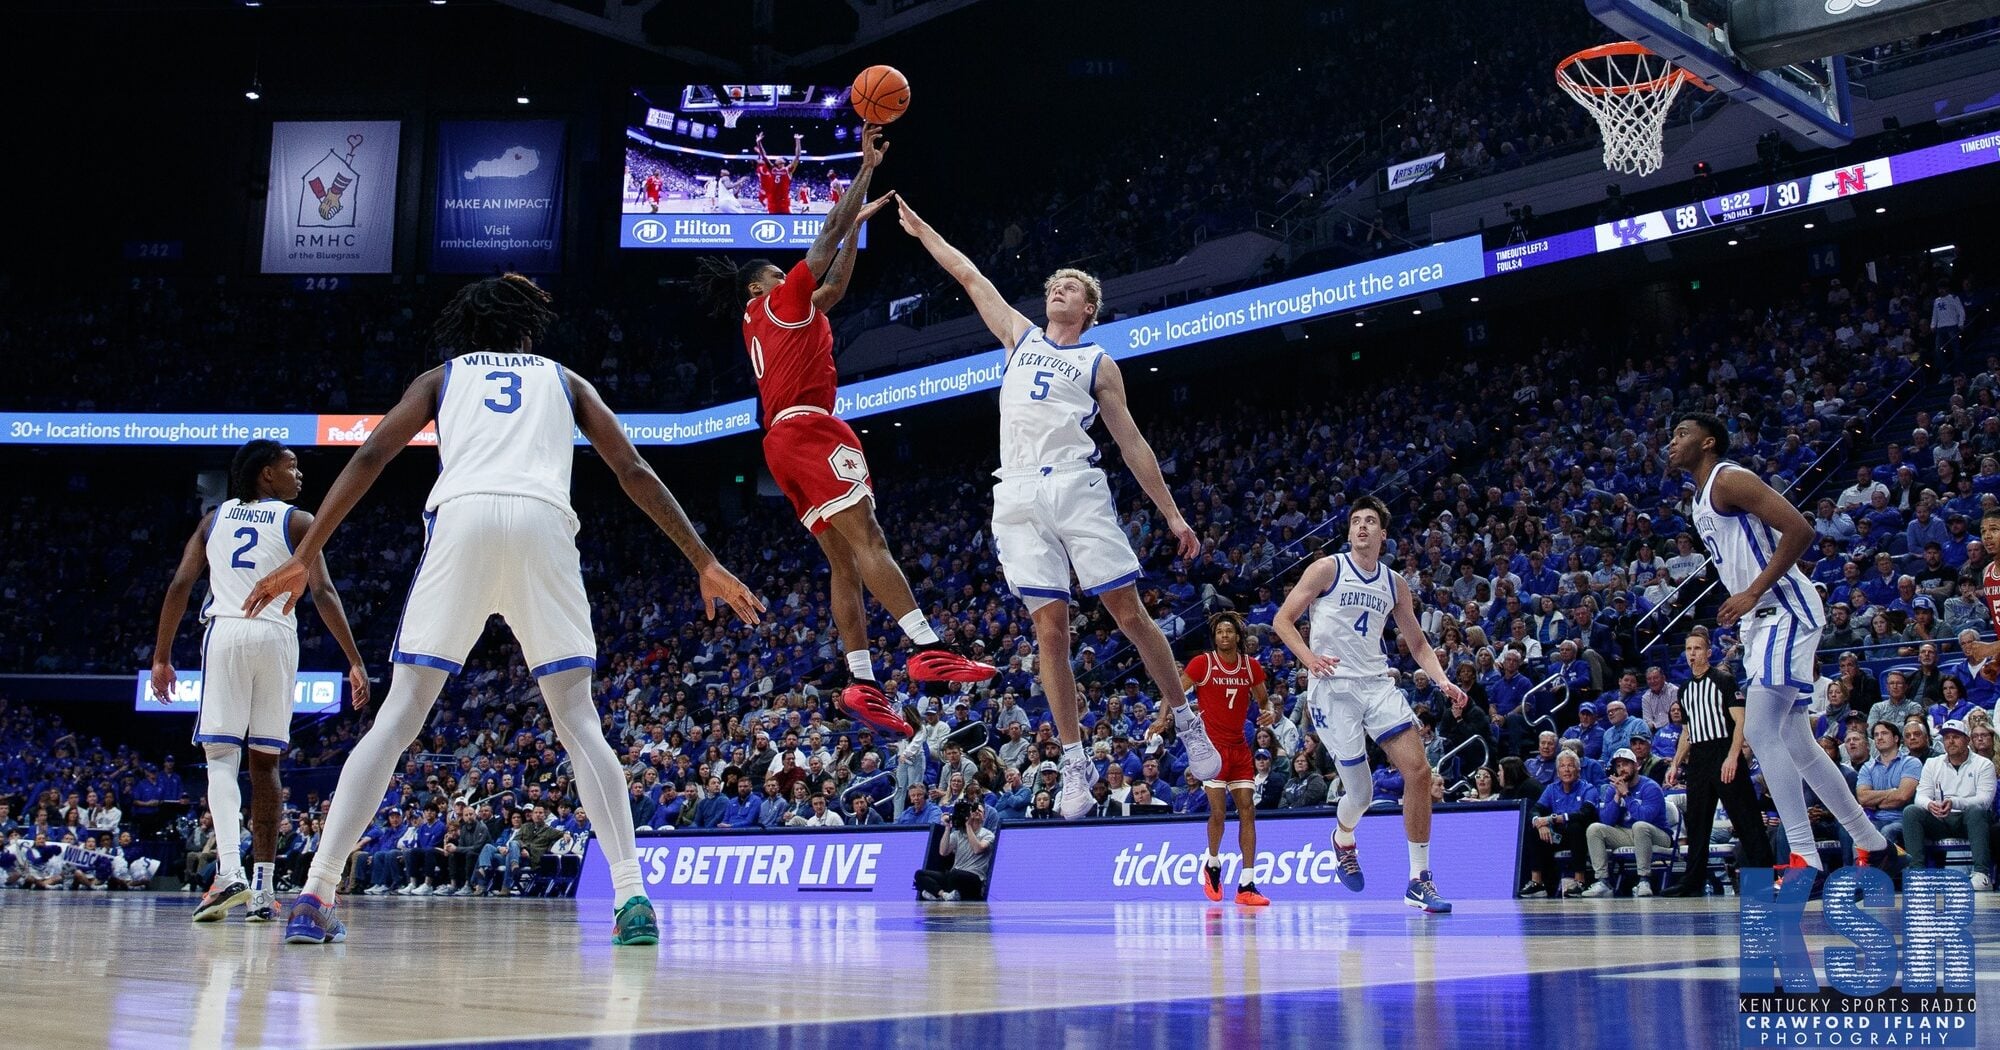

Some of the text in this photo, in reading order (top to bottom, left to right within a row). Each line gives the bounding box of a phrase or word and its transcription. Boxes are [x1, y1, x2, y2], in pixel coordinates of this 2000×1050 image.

[445, 199, 552, 209] MAKE AN IMPACT.
[1721, 193, 1750, 212] 9:22
[1776, 182, 1800, 207] 30
[1675, 206, 1698, 229] 58
[1722, 208, 1753, 221] 2ND HALF
[484, 225, 511, 235] Visit
[675, 220, 731, 235] Hilton
[295, 234, 355, 247] RMHC
[440, 238, 553, 250] rmhclexington.org
[316, 252, 360, 261] Bluegrass
[1496, 241, 1548, 261] TIMEOUTS LEFT:3
[1497, 260, 1522, 272] FOULS:4
[306, 277, 338, 290] 242
[1128, 263, 1443, 349] 30+ locations throughout the area
[463, 354, 545, 367] WILLIAMS
[750, 336, 765, 379] 0
[1017, 352, 1082, 382] KENTUCKY
[484, 370, 522, 414] 3
[834, 362, 1001, 416] 0+ locations throughout
[1030, 371, 1055, 400] 5
[11, 421, 289, 441] 30+ locations throughout the area
[623, 412, 750, 441] hroughout the area
[225, 507, 276, 524] JOHNSON
[231, 527, 259, 569] 2
[1339, 592, 1388, 615] KENTUCKY
[1353, 611, 1369, 637] 4
[1213, 677, 1250, 685] NICHOLLS
[1226, 688, 1238, 709] 7
[671, 845, 794, 885] BETTER
[799, 843, 882, 885] LIVE
[1112, 841, 1347, 887] ticketmaste
